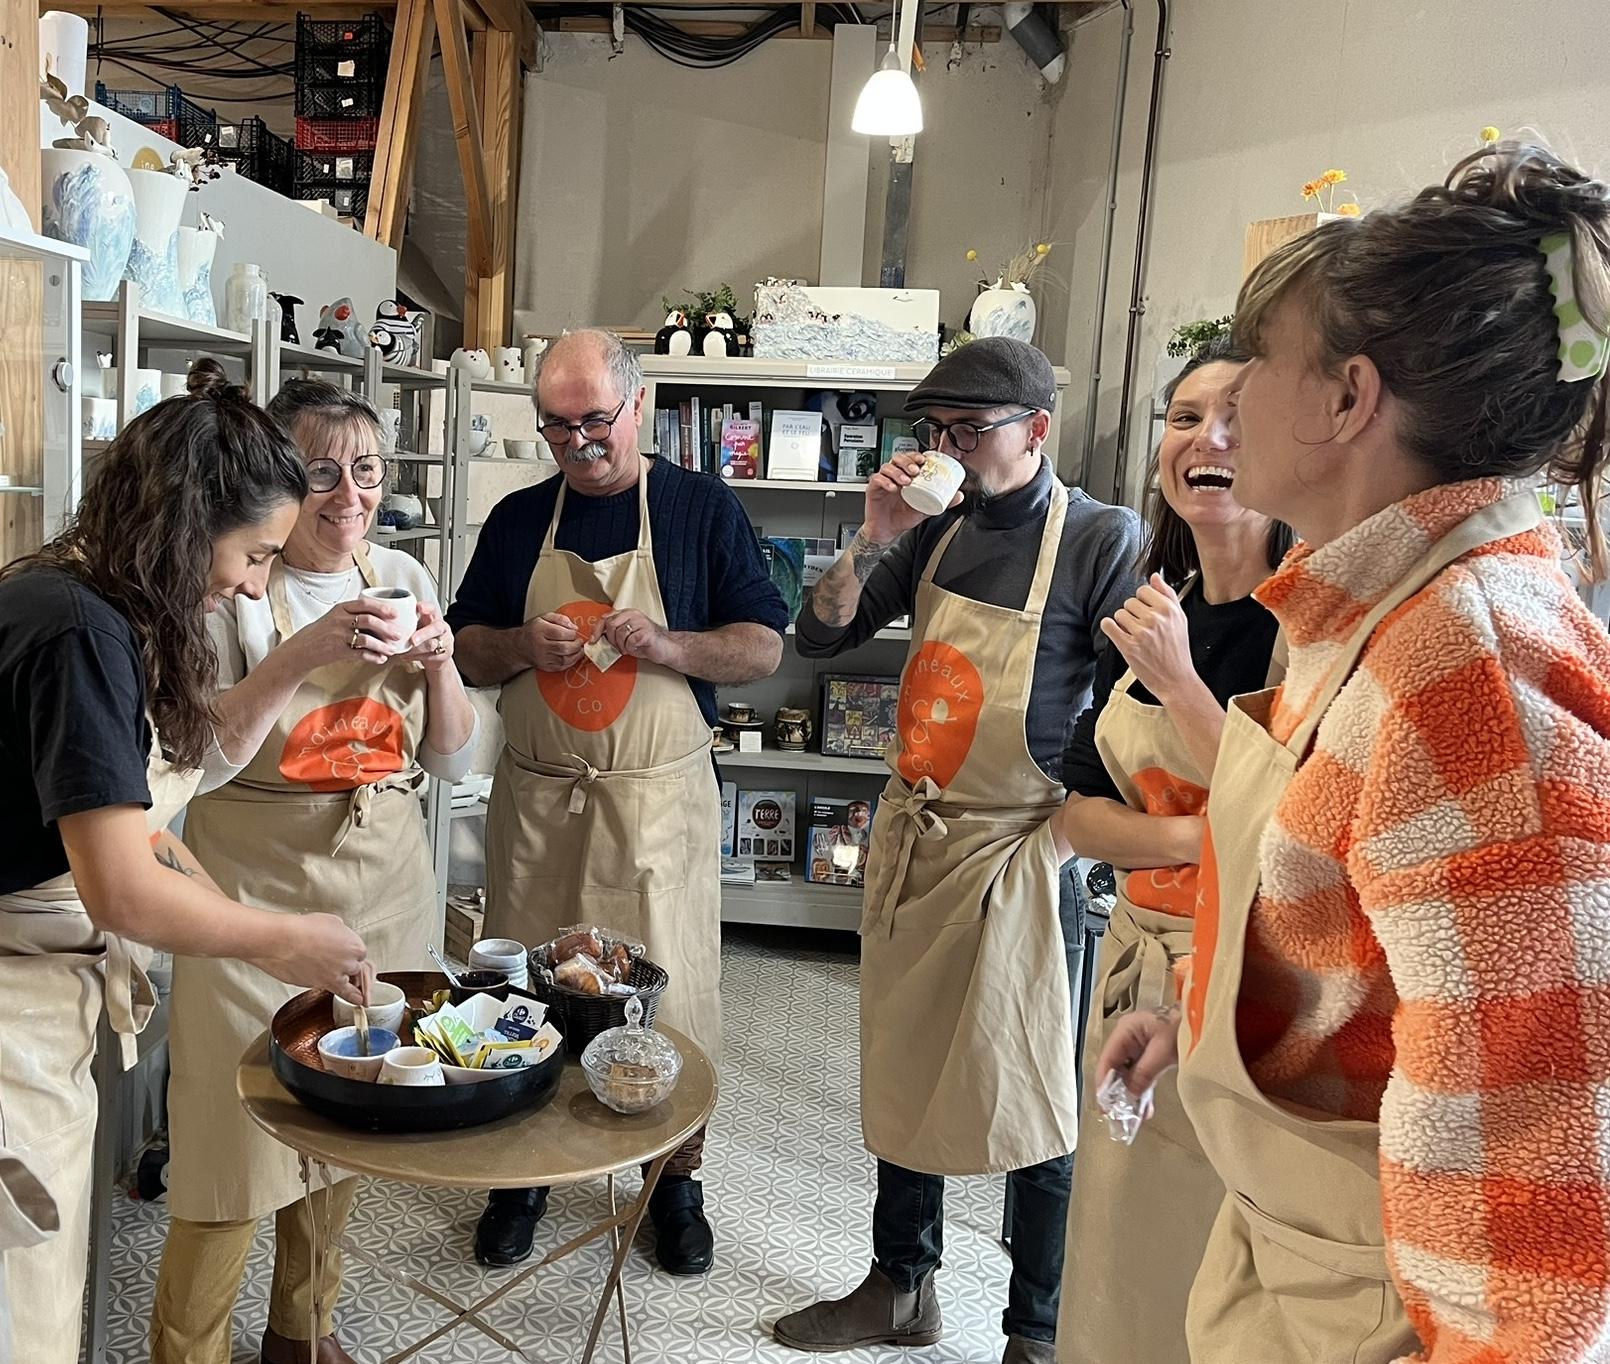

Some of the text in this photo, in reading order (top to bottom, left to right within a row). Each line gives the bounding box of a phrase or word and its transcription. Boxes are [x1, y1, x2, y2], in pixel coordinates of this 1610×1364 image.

[577, 697, 602, 714] Co
[911, 754, 934, 773] Co
[754, 808, 780, 820] TERRE
